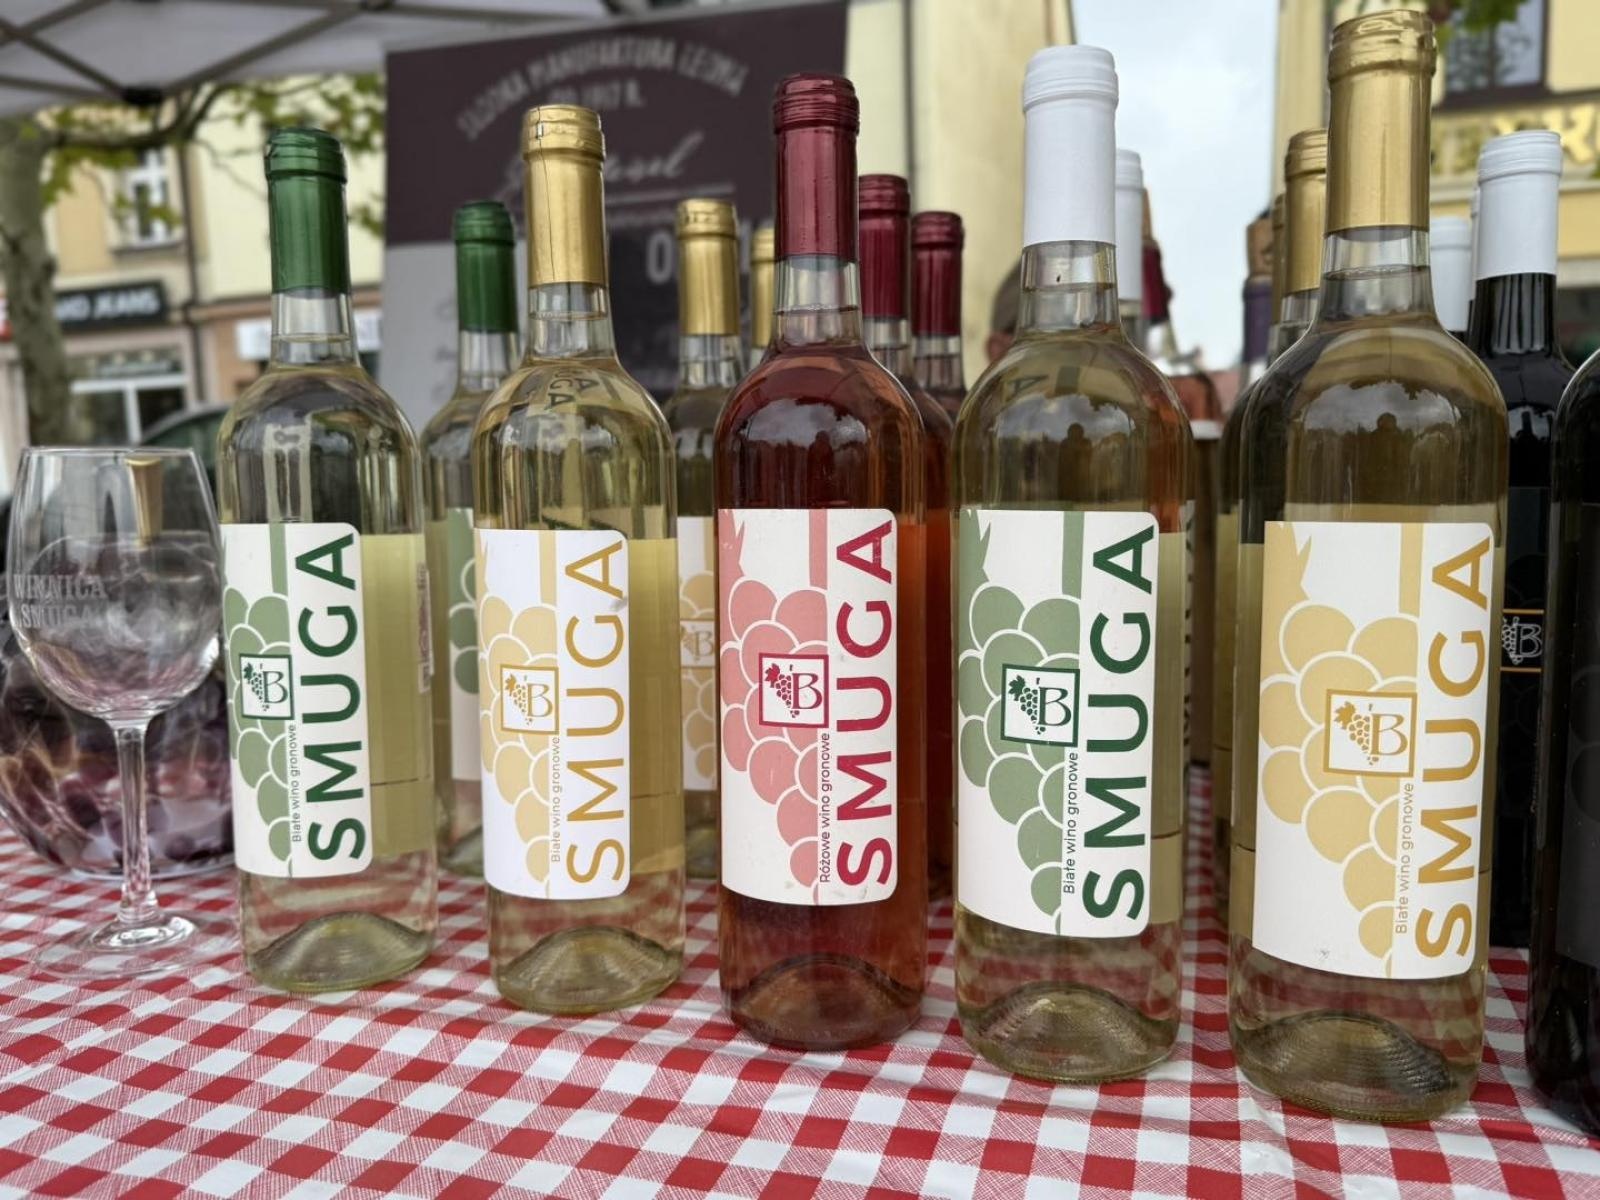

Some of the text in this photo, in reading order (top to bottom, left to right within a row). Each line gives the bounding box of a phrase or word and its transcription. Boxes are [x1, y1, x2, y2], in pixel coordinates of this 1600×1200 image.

[288, 724, 300, 776] gronowe
[295, 532, 365, 861] SMUGA
[552, 736, 562, 793] gronowe
[565, 540, 625, 883] SMUGA
[836, 520, 892, 887] SMUGA
[1082, 525, 1155, 921] SMUGA
[1415, 537, 1491, 960] SMUGA
[290, 780, 300, 810] wino
[550, 796, 560, 829] wino
[819, 732, 832, 883] Różowe wino gronowe
[1063, 752, 1079, 894] Białe wino gronowe
[1395, 783, 1414, 934] Białe wino gronowe
